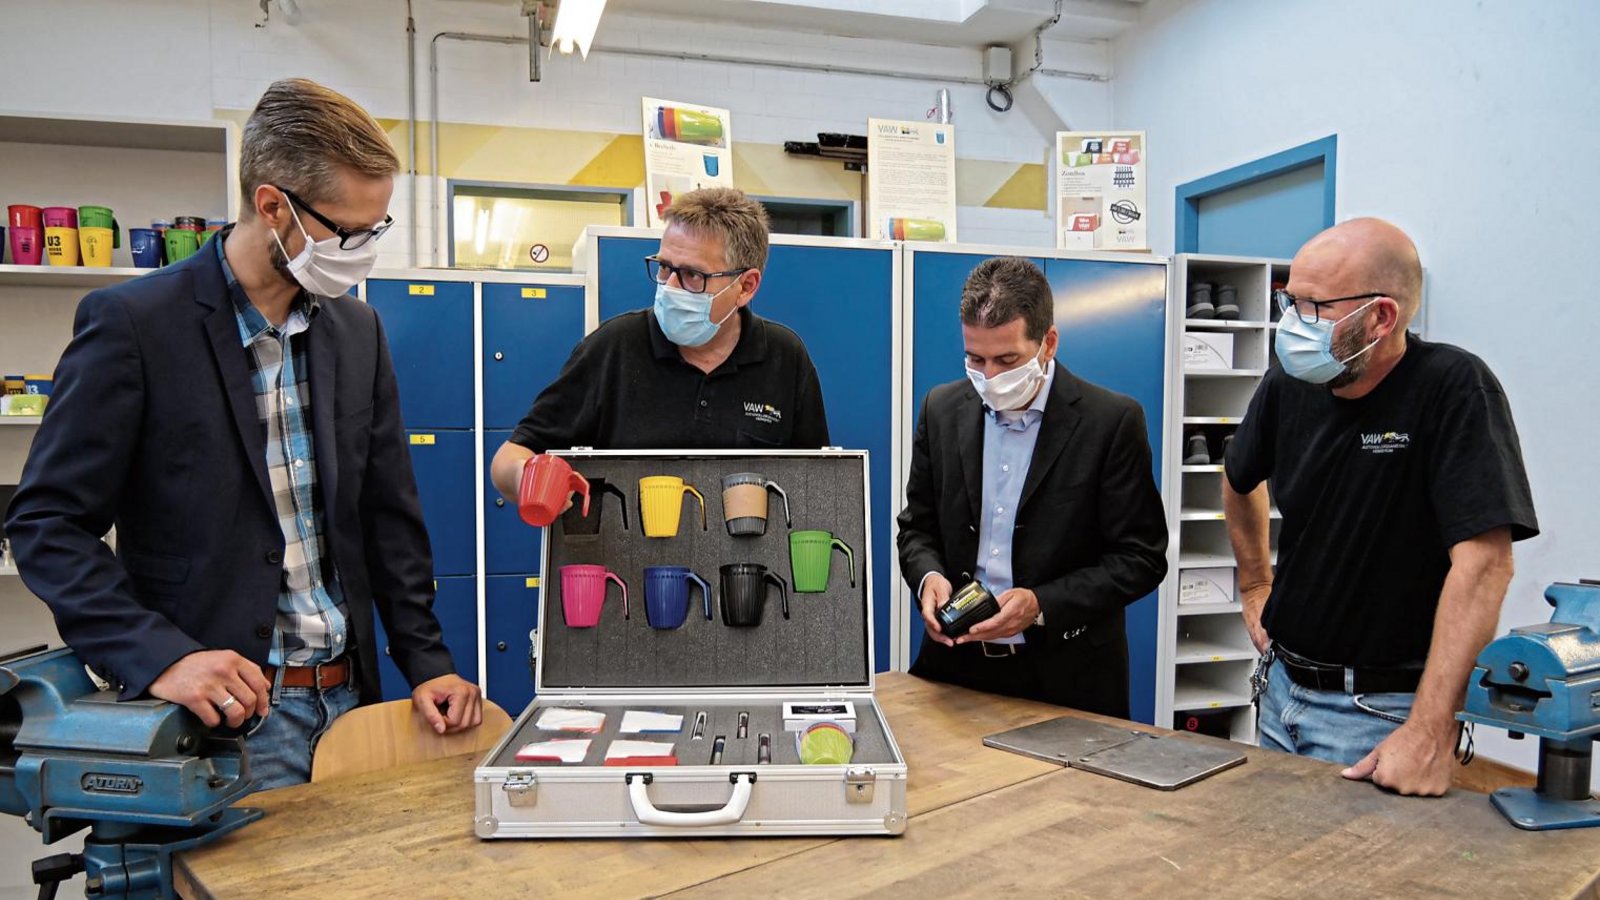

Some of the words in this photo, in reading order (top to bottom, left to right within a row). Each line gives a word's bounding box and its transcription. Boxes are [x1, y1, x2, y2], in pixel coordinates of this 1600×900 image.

[47, 236, 61, 247] U3
[419, 286, 425, 294] 2
[531, 289, 537, 297] 3
[743, 401, 763, 412] VAW
[419, 435, 426, 443] 5
[1361, 433, 1383, 444] VAW
[86, 775, 138, 789] ATORN
